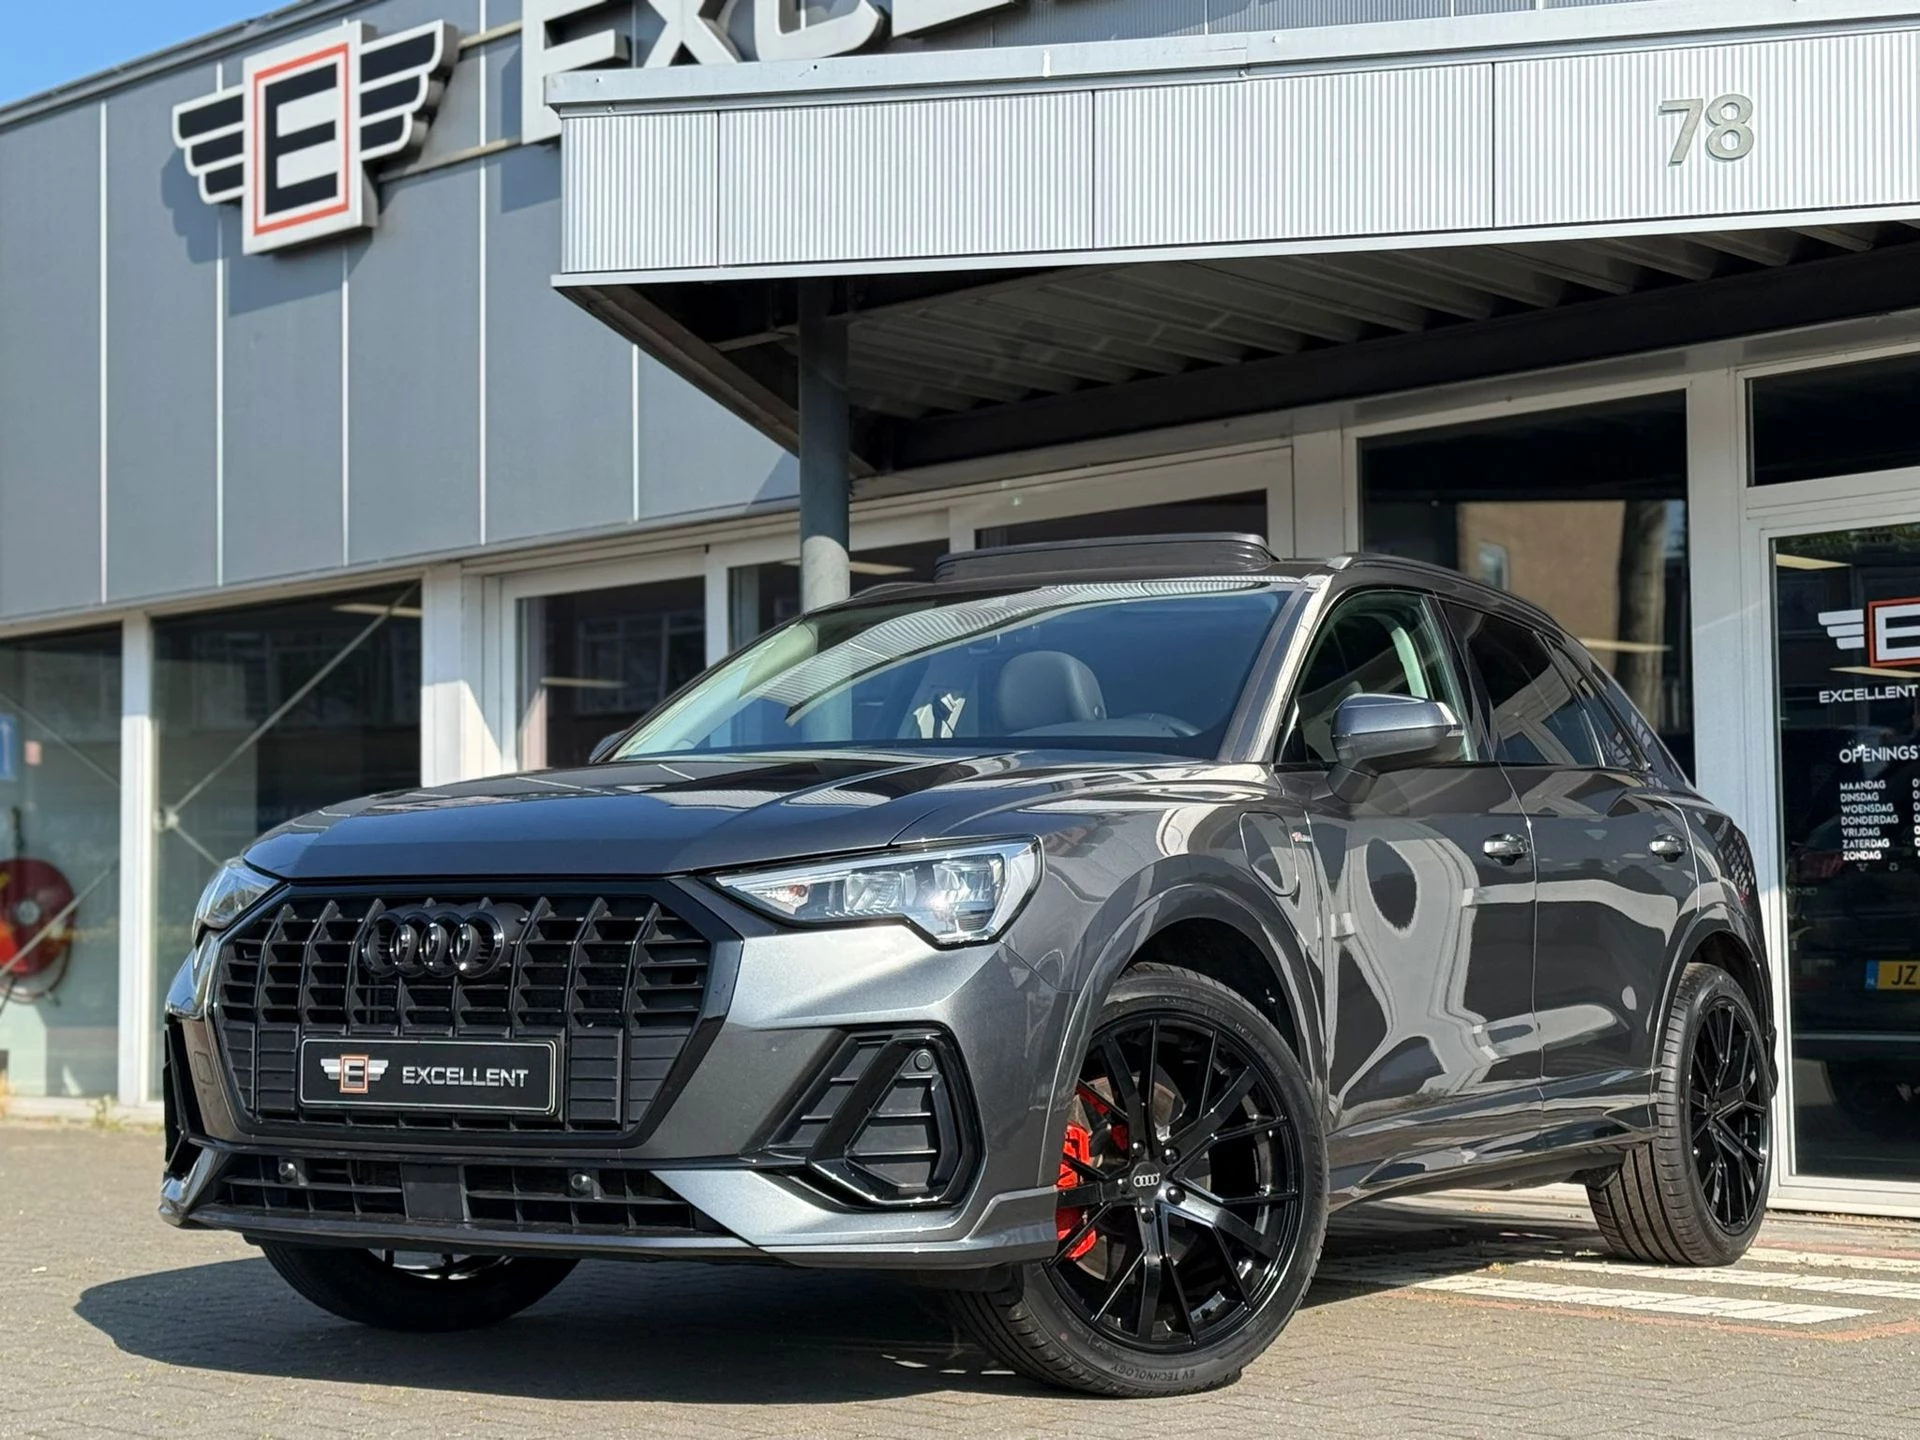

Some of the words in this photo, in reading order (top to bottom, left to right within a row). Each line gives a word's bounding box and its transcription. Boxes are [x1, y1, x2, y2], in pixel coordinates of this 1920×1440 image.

[1658, 93, 1755, 167] 78
[1819, 684, 1918, 703] EXCELLENT
[1839, 744, 1920, 763] OPENINGS
[1840, 780, 1886, 790] MAANDAG
[1840, 792, 1879, 802] DINSDAG
[1841, 803, 1894, 814] WOENSDAG
[1841, 815, 1899, 826] DONDERDAG
[1841, 827, 1881, 837] VRIJDAG
[1842, 838, 1890, 849] ZATERDAG
[1842, 850, 1882, 861] ZONDAG
[402, 1066, 529, 1088] EXCELLENT
[1110, 1363, 1179, 1381] TECHNOLOGY
